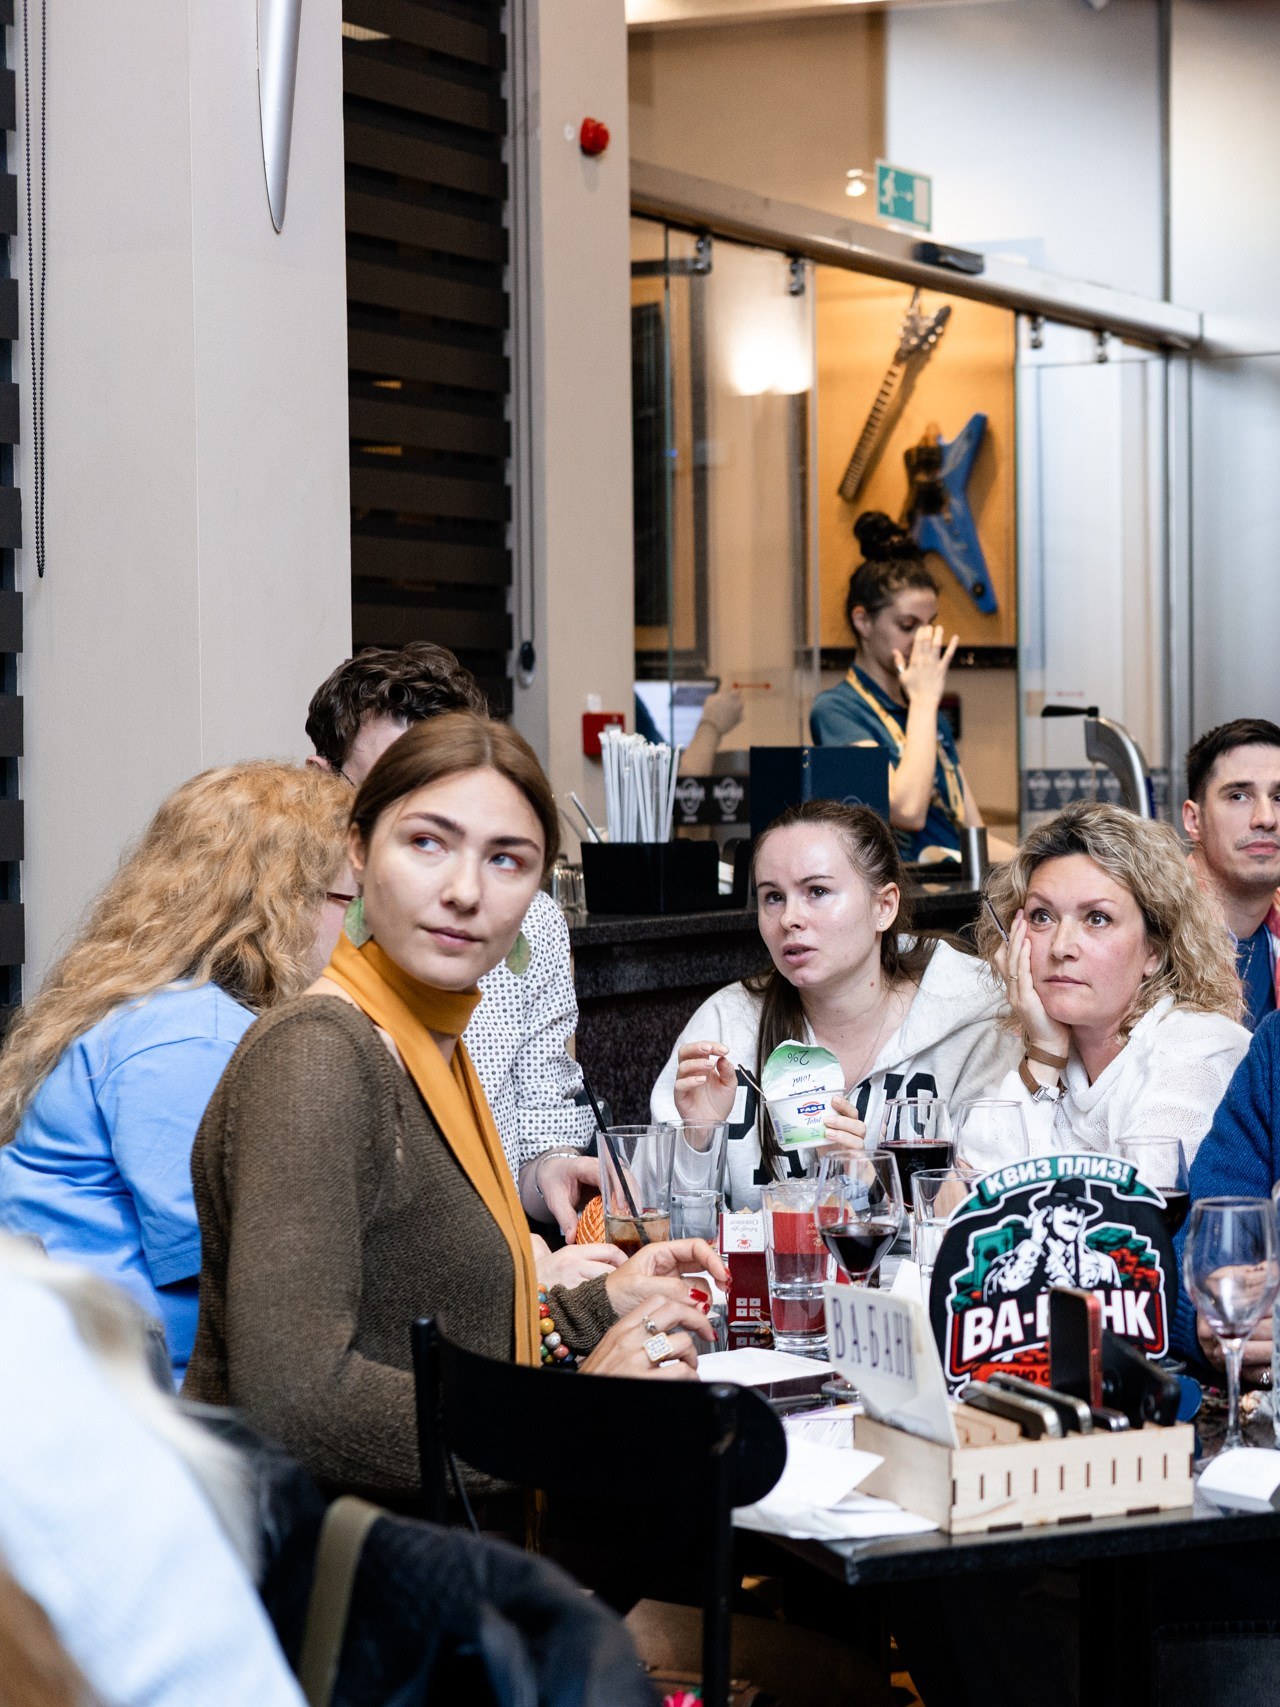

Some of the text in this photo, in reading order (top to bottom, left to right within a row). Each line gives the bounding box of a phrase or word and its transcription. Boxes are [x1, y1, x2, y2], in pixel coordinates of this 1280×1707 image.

[787, 1050, 810, 1065] 2%
[985, 1156, 1130, 1196] КВИЗ ПЛИЗ!
[961, 1289, 1156, 1363] ВА-НК
